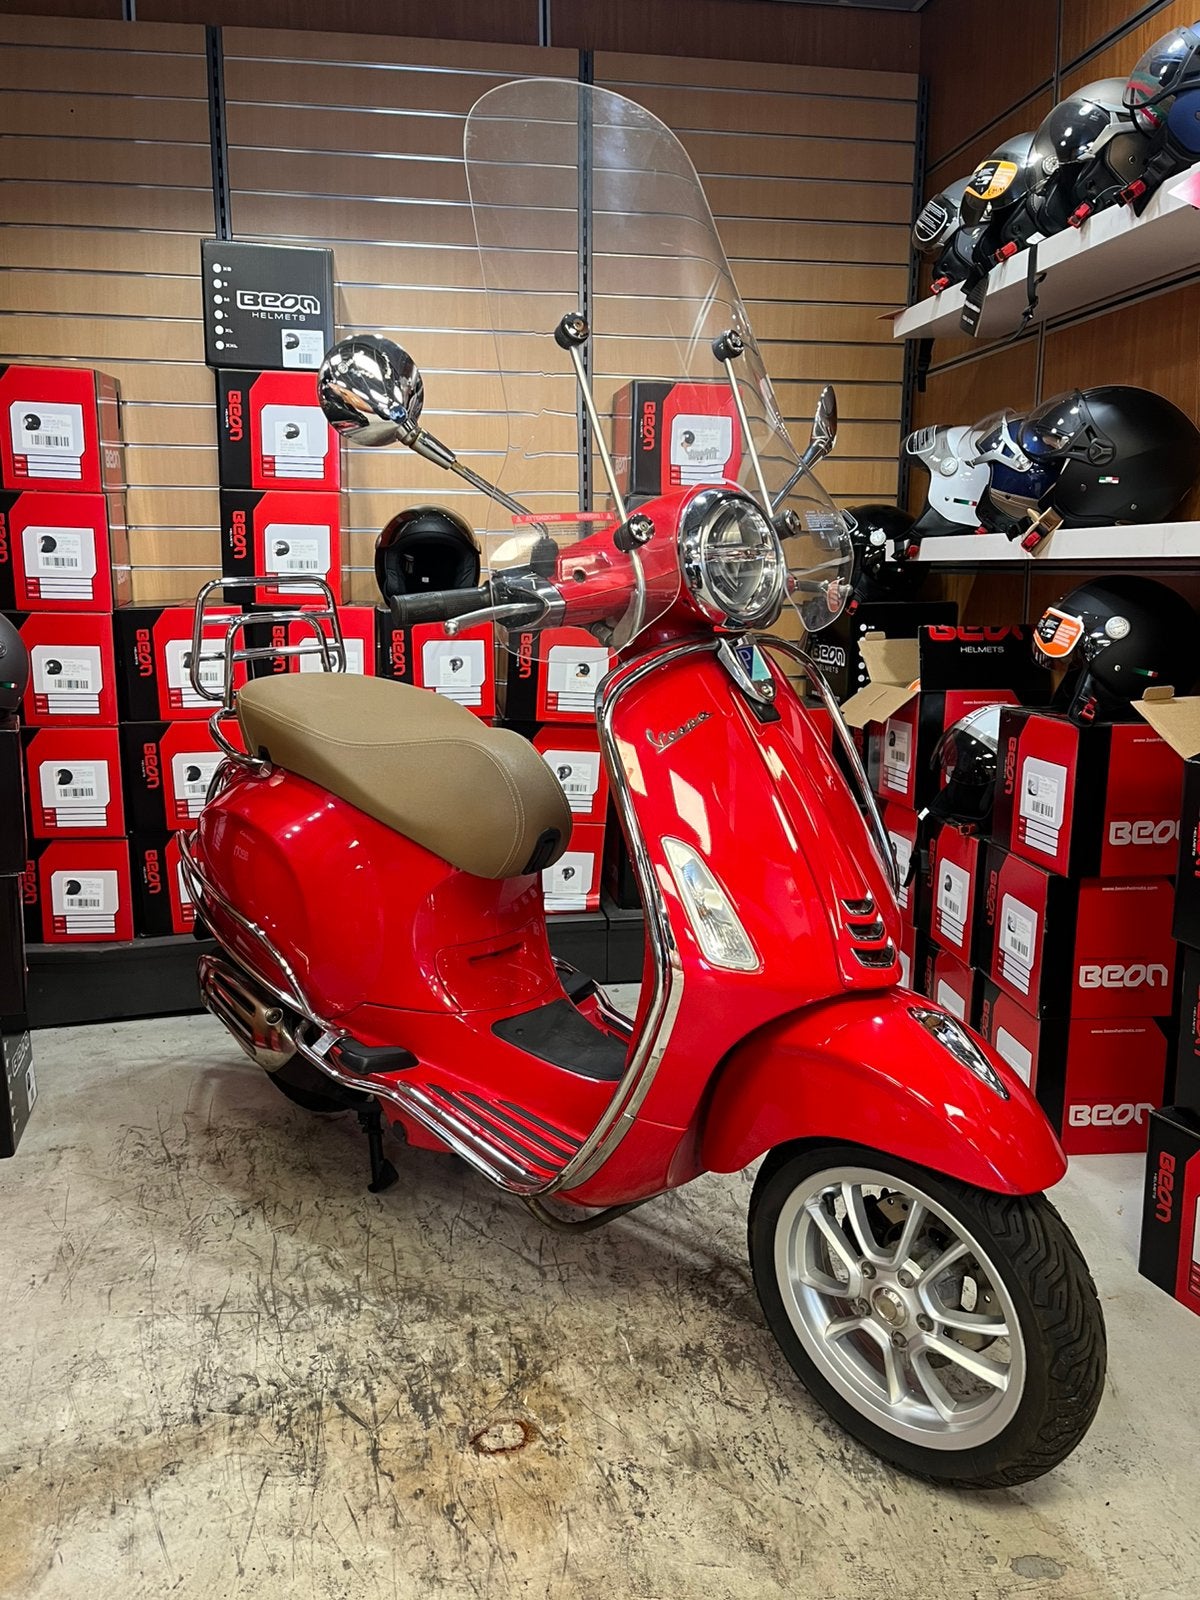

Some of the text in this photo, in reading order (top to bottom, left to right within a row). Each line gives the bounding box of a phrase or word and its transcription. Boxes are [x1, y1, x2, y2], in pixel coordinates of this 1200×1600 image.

[251, 311, 306, 322] HELMETS
[959, 646, 1005, 654] HELMETS
[645, 710, 714, 755] Vespa
